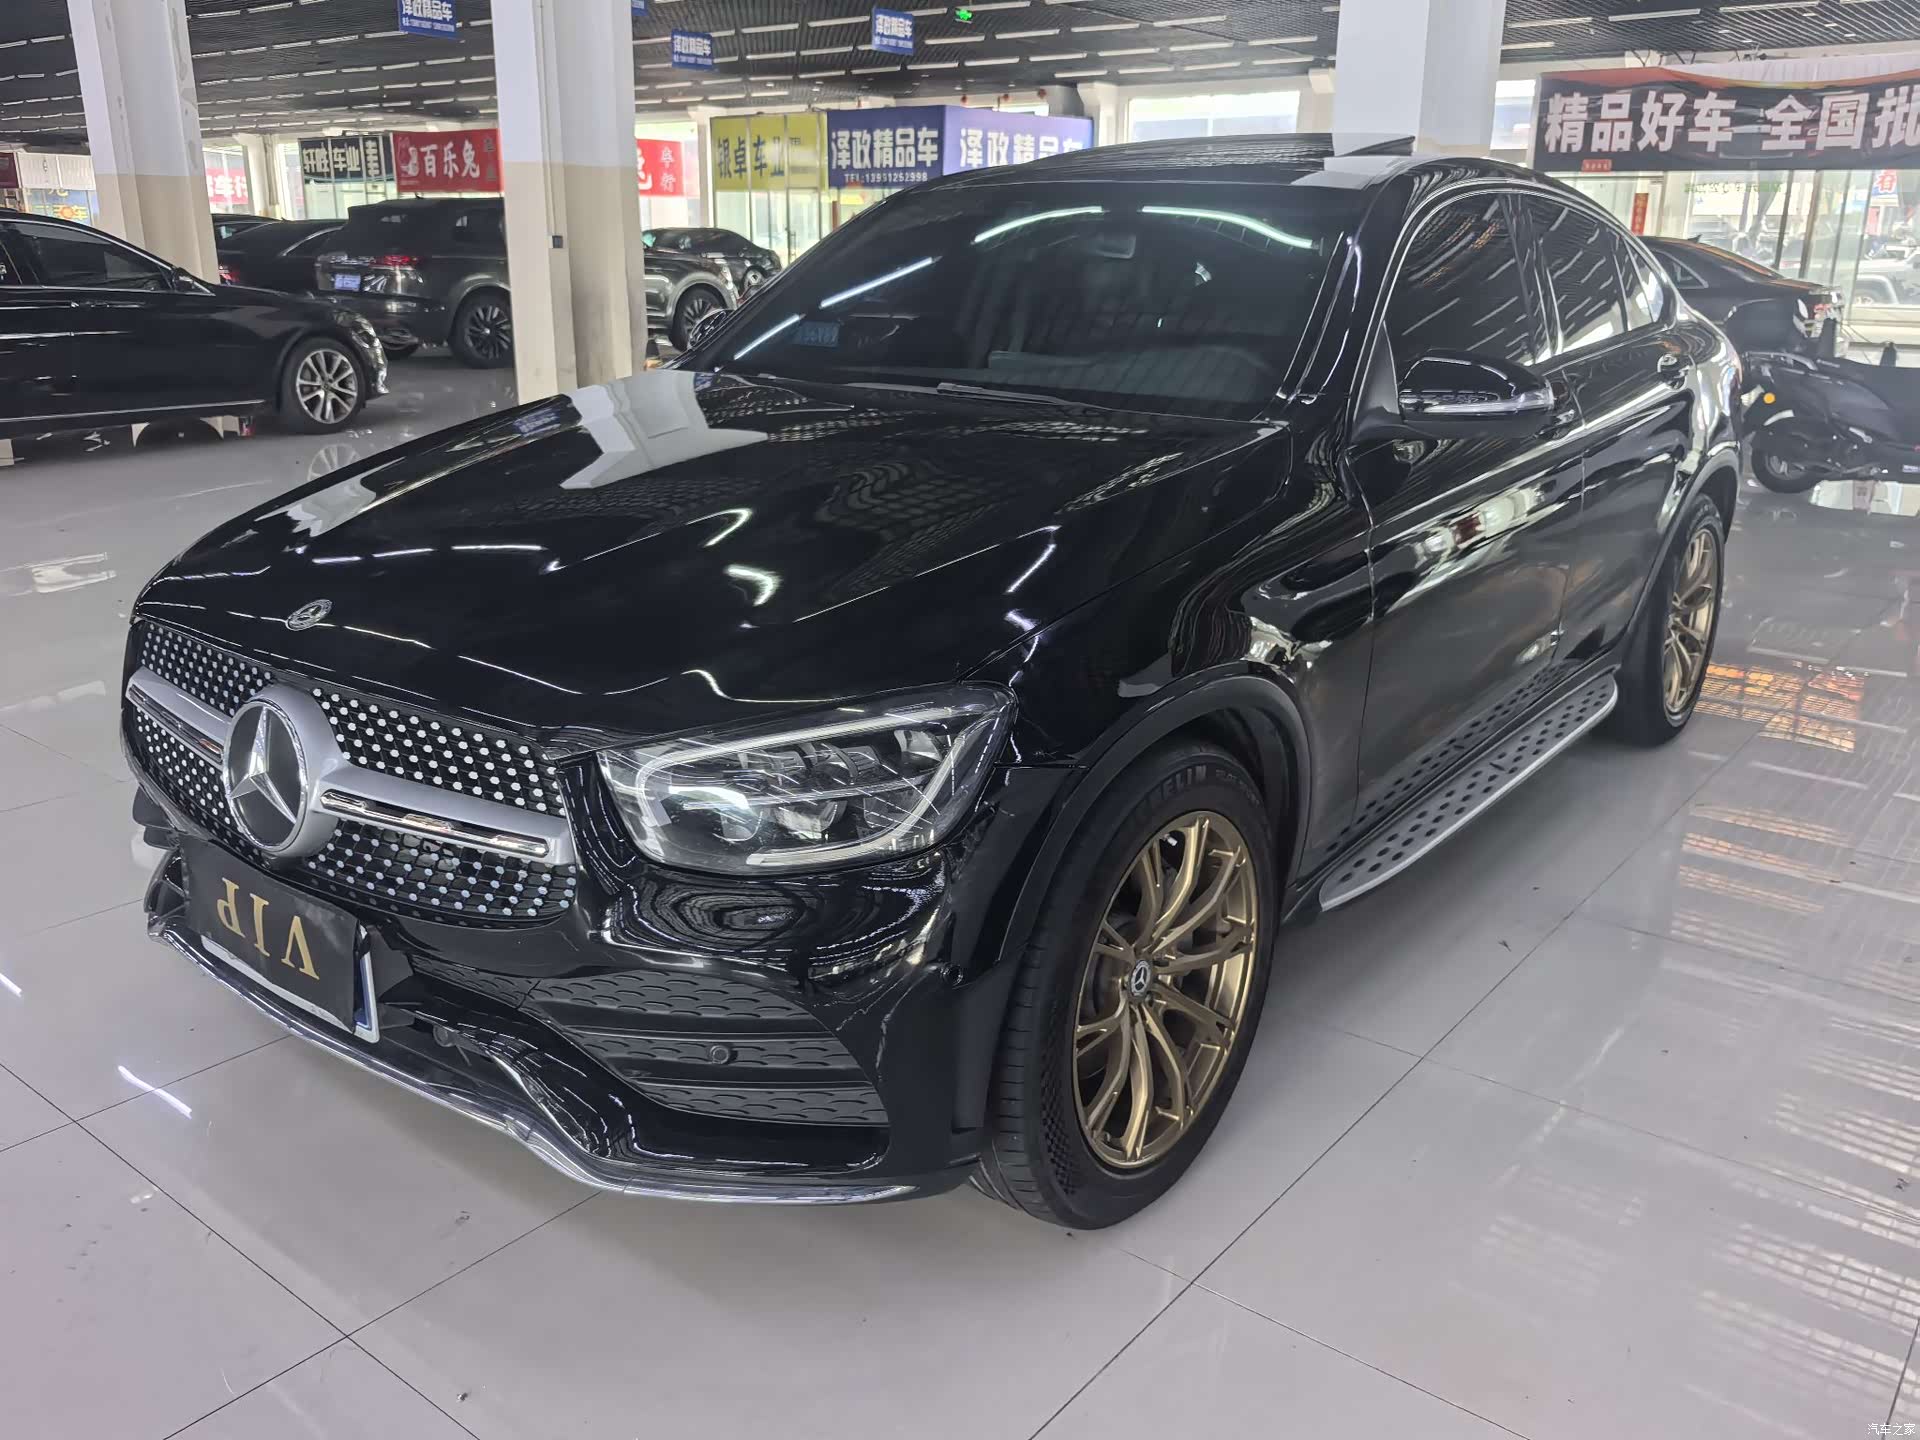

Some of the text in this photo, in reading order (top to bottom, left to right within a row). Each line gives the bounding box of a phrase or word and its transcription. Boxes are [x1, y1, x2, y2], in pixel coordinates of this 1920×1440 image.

[832, 126, 939, 170] 泽政精品车
[1545, 90, 1737, 153] 精品好车
[216, 876, 320, 981] VIP
